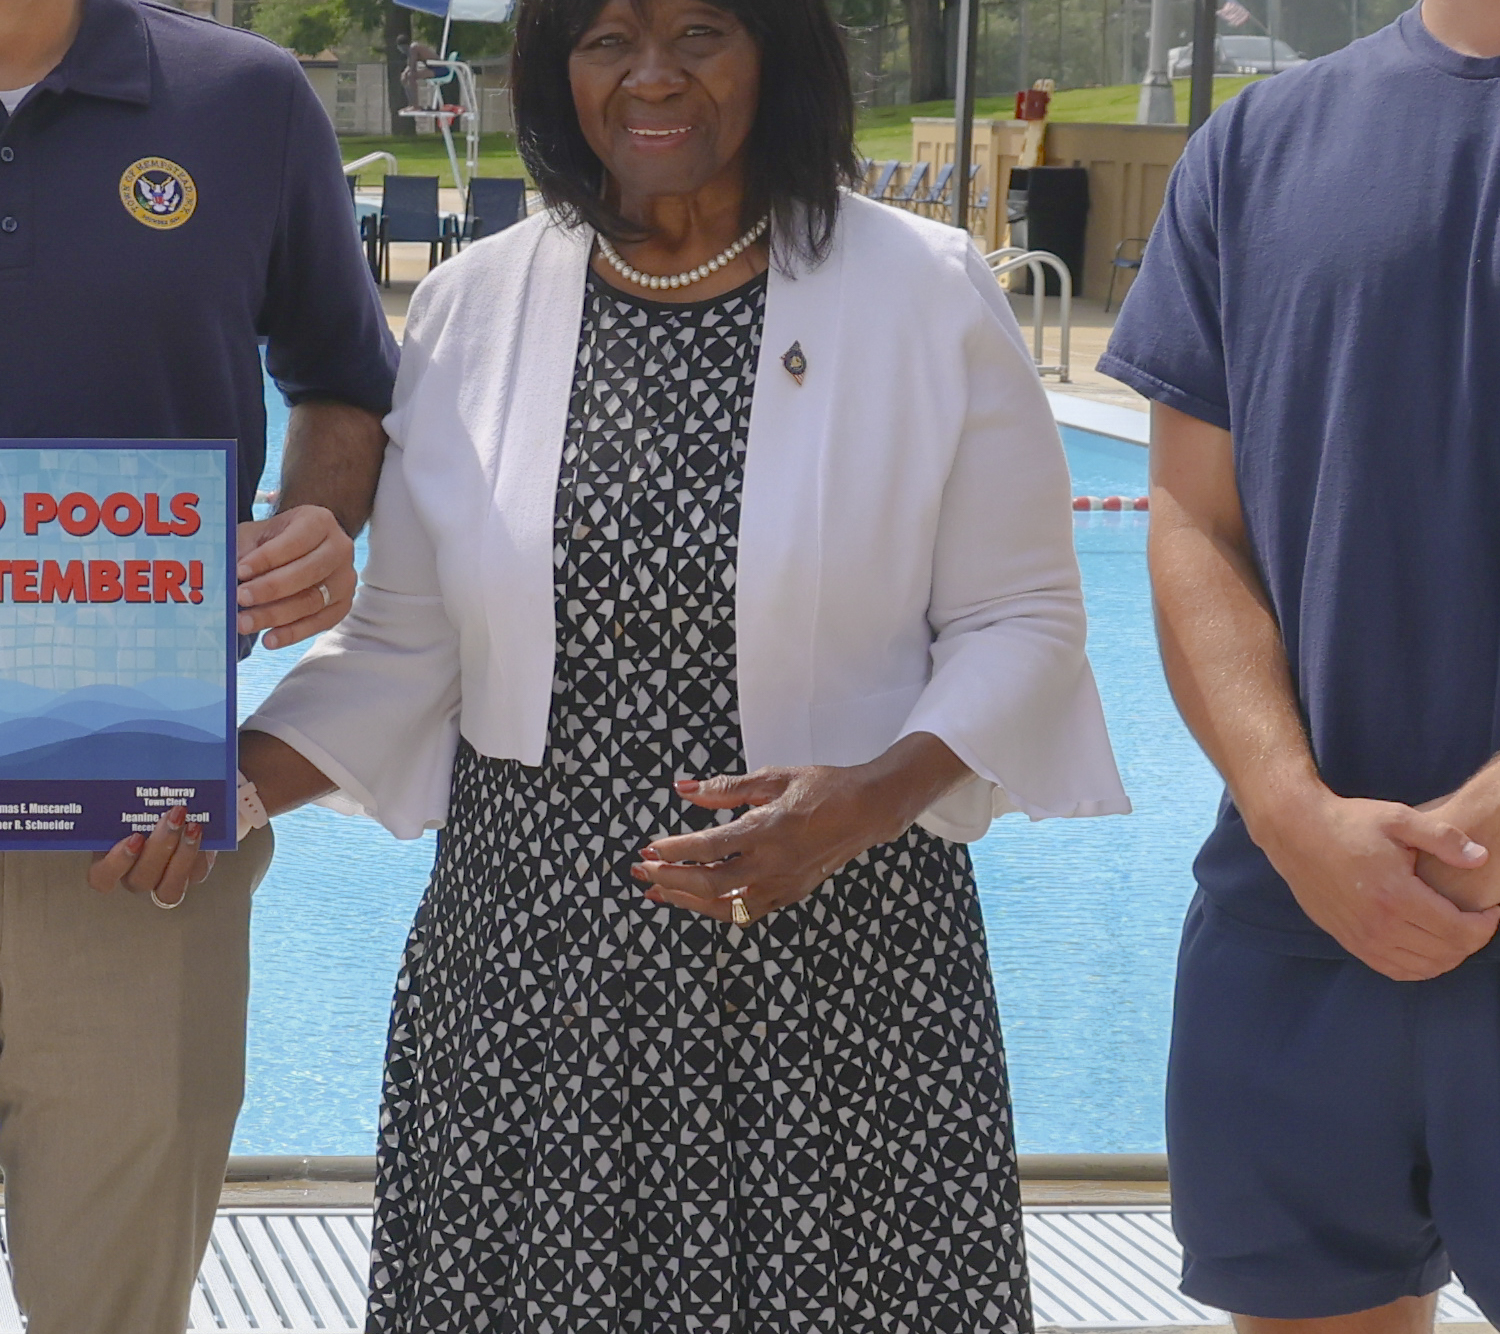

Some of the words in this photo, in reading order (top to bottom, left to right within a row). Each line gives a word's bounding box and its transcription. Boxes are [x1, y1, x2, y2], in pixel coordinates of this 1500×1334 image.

[24, 492, 202, 537] POOLS
[136, 786, 159, 797] Kate
[160, 786, 196, 798] Murray
[144, 798, 165, 806] Town
[166, 798, 188, 806] Clerk
[20, 803, 28, 814] E.
[29, 803, 82, 814] Muscarella
[121, 811, 160, 822] Jeanine
[14, 819, 24, 830] R.
[25, 819, 75, 830] Schneider
